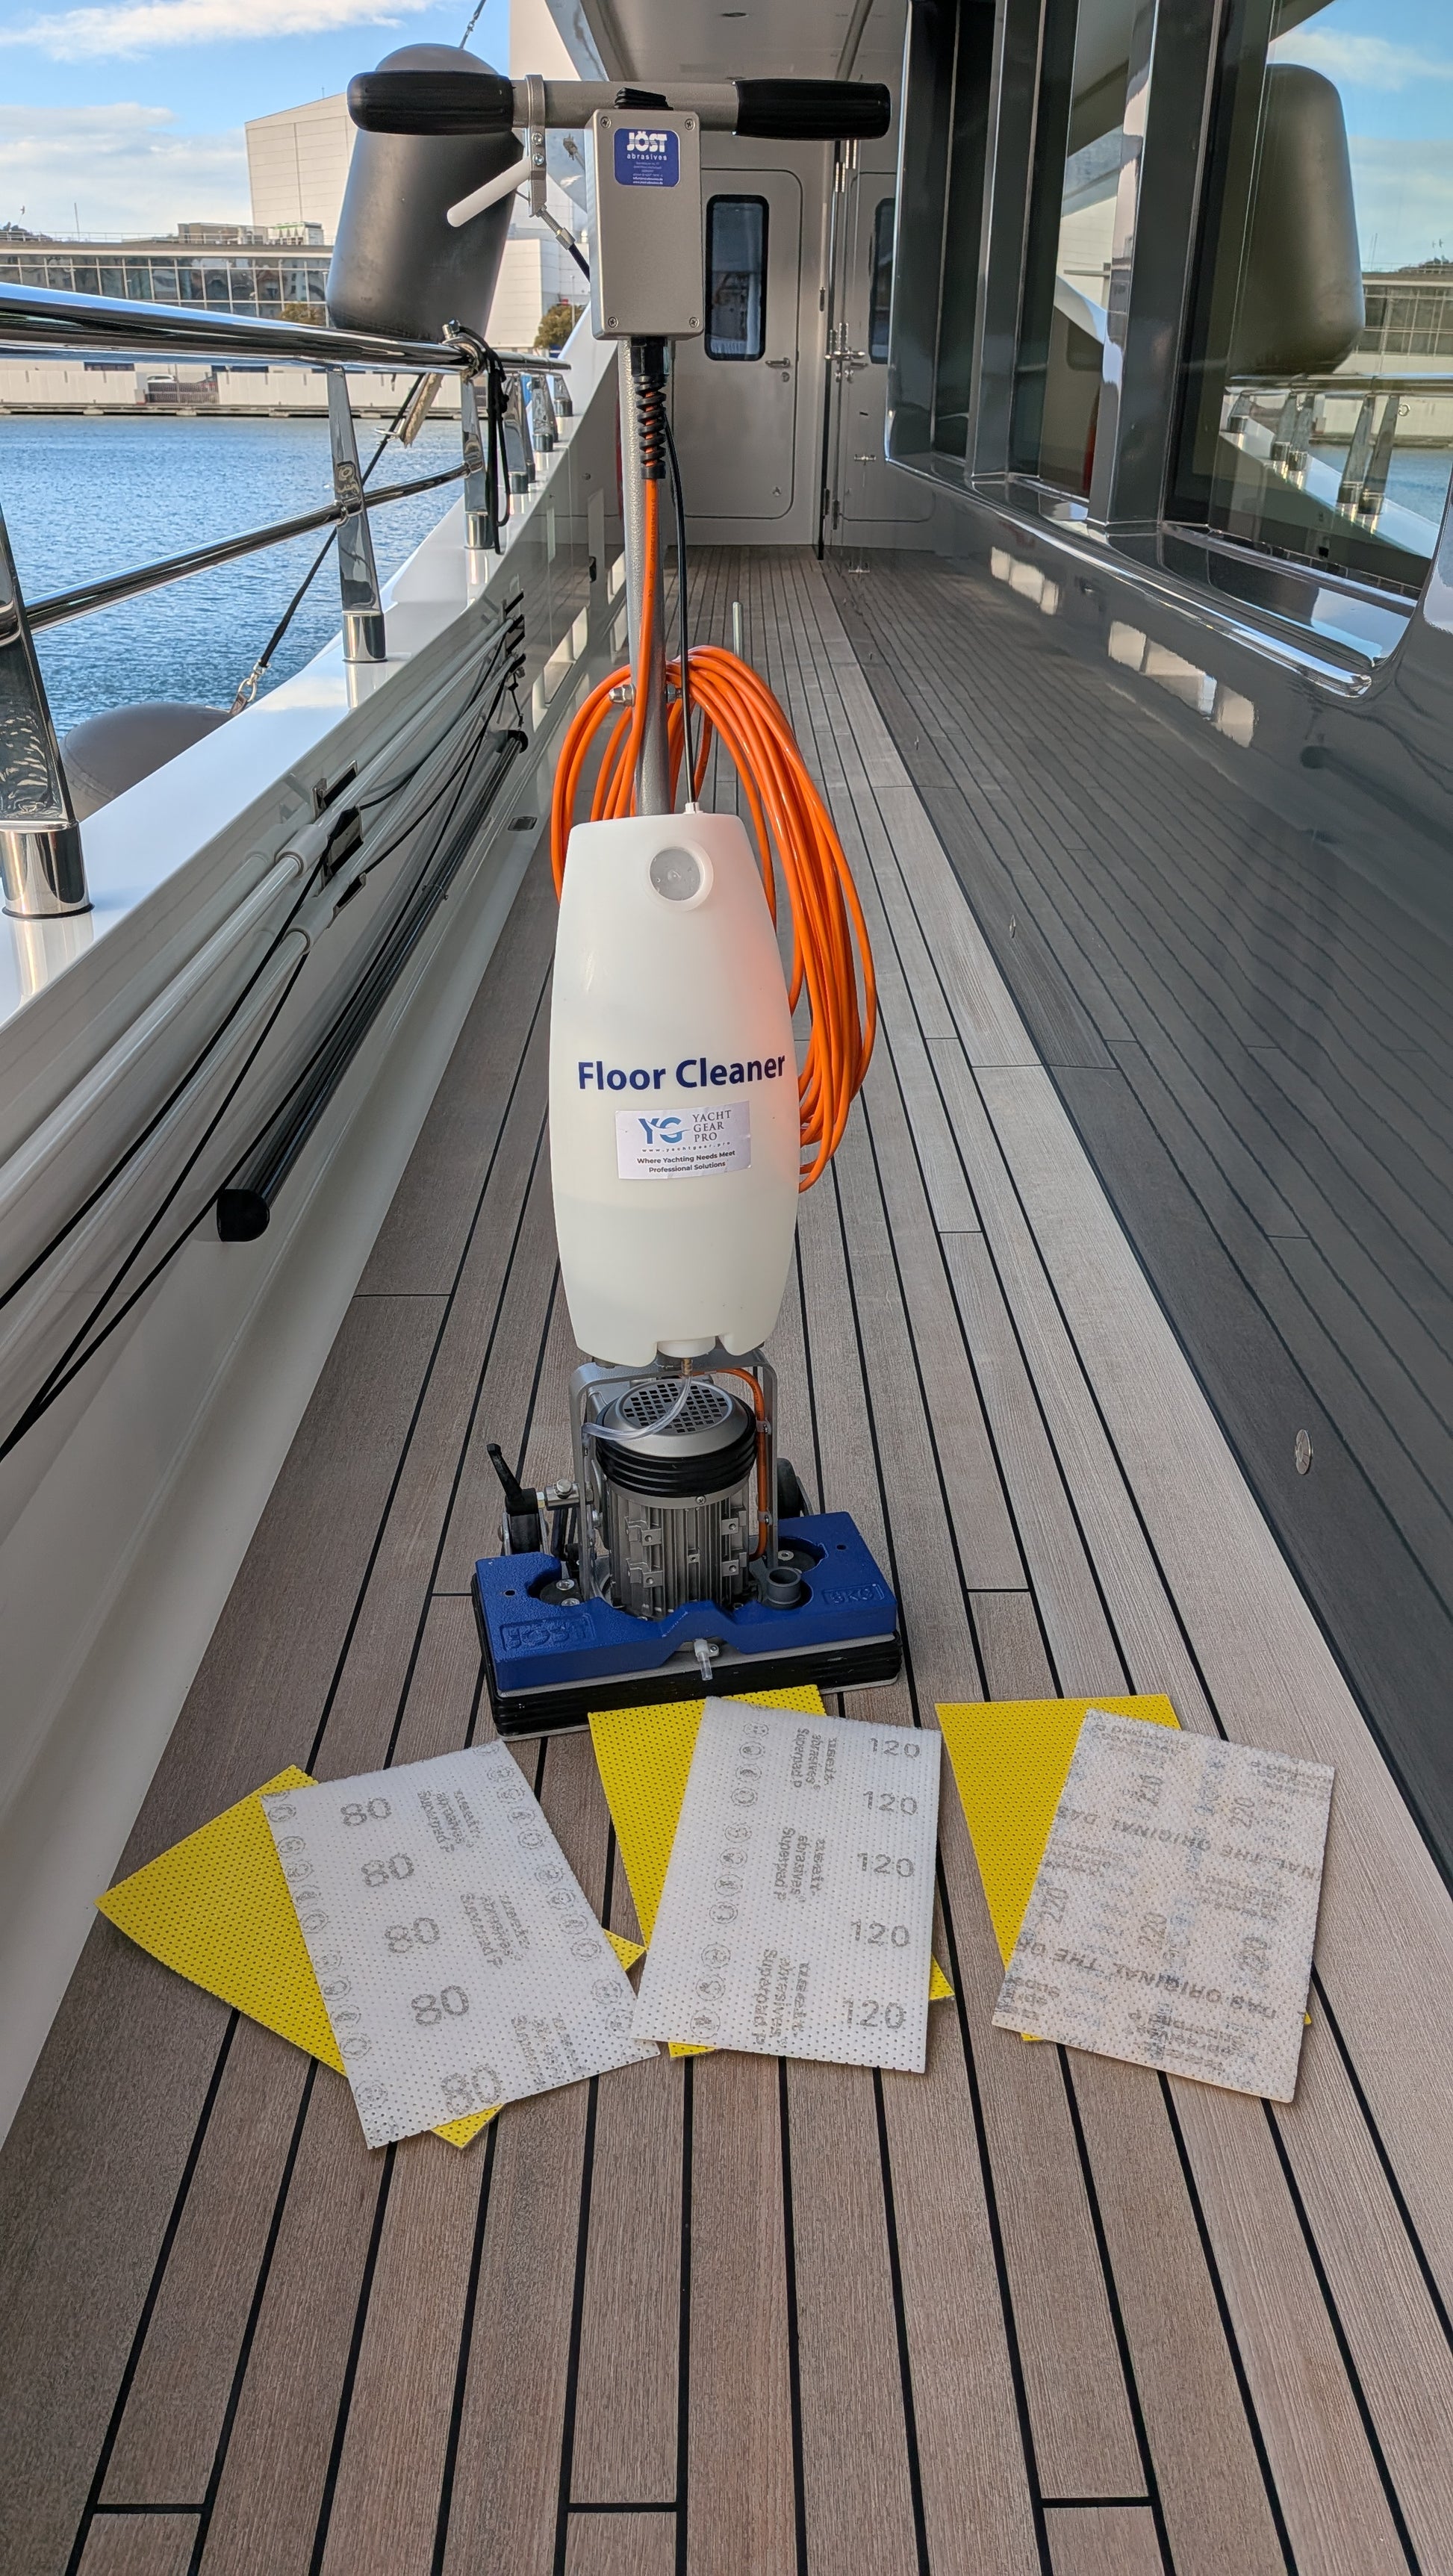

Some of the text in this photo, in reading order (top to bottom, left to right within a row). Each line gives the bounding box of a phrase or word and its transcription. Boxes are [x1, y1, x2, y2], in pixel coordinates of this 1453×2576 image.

[626, 131, 668, 153] JÖST
[578, 1055, 785, 1091] Floor Cleaner
[692, 1110, 732, 1123] YACHT
[693, 1121, 725, 1133] GEAR
[638, 1117, 683, 1144] YG
[694, 1132, 718, 1143] PRO
[641, 1141, 731, 1153] www.yachtgear.pro
[662, 1155, 695, 1165] Yachting
[696, 1153, 718, 1161] Needs
[718, 1150, 736, 1159] Meet
[648, 1161, 726, 1173] Professional Solutions
[869, 1737, 921, 1759] 120
[340, 1796, 392, 1827] 80
[862, 1790, 918, 1816] 120
[361, 1852, 415, 1888] 80
[858, 1851, 915, 1879] 120
[384, 1917, 441, 1954] 80
[850, 1918, 911, 1948] 120
[411, 1984, 470, 2027] 80
[841, 1995, 906, 2030] 120
[440, 2062, 503, 2116] 80
